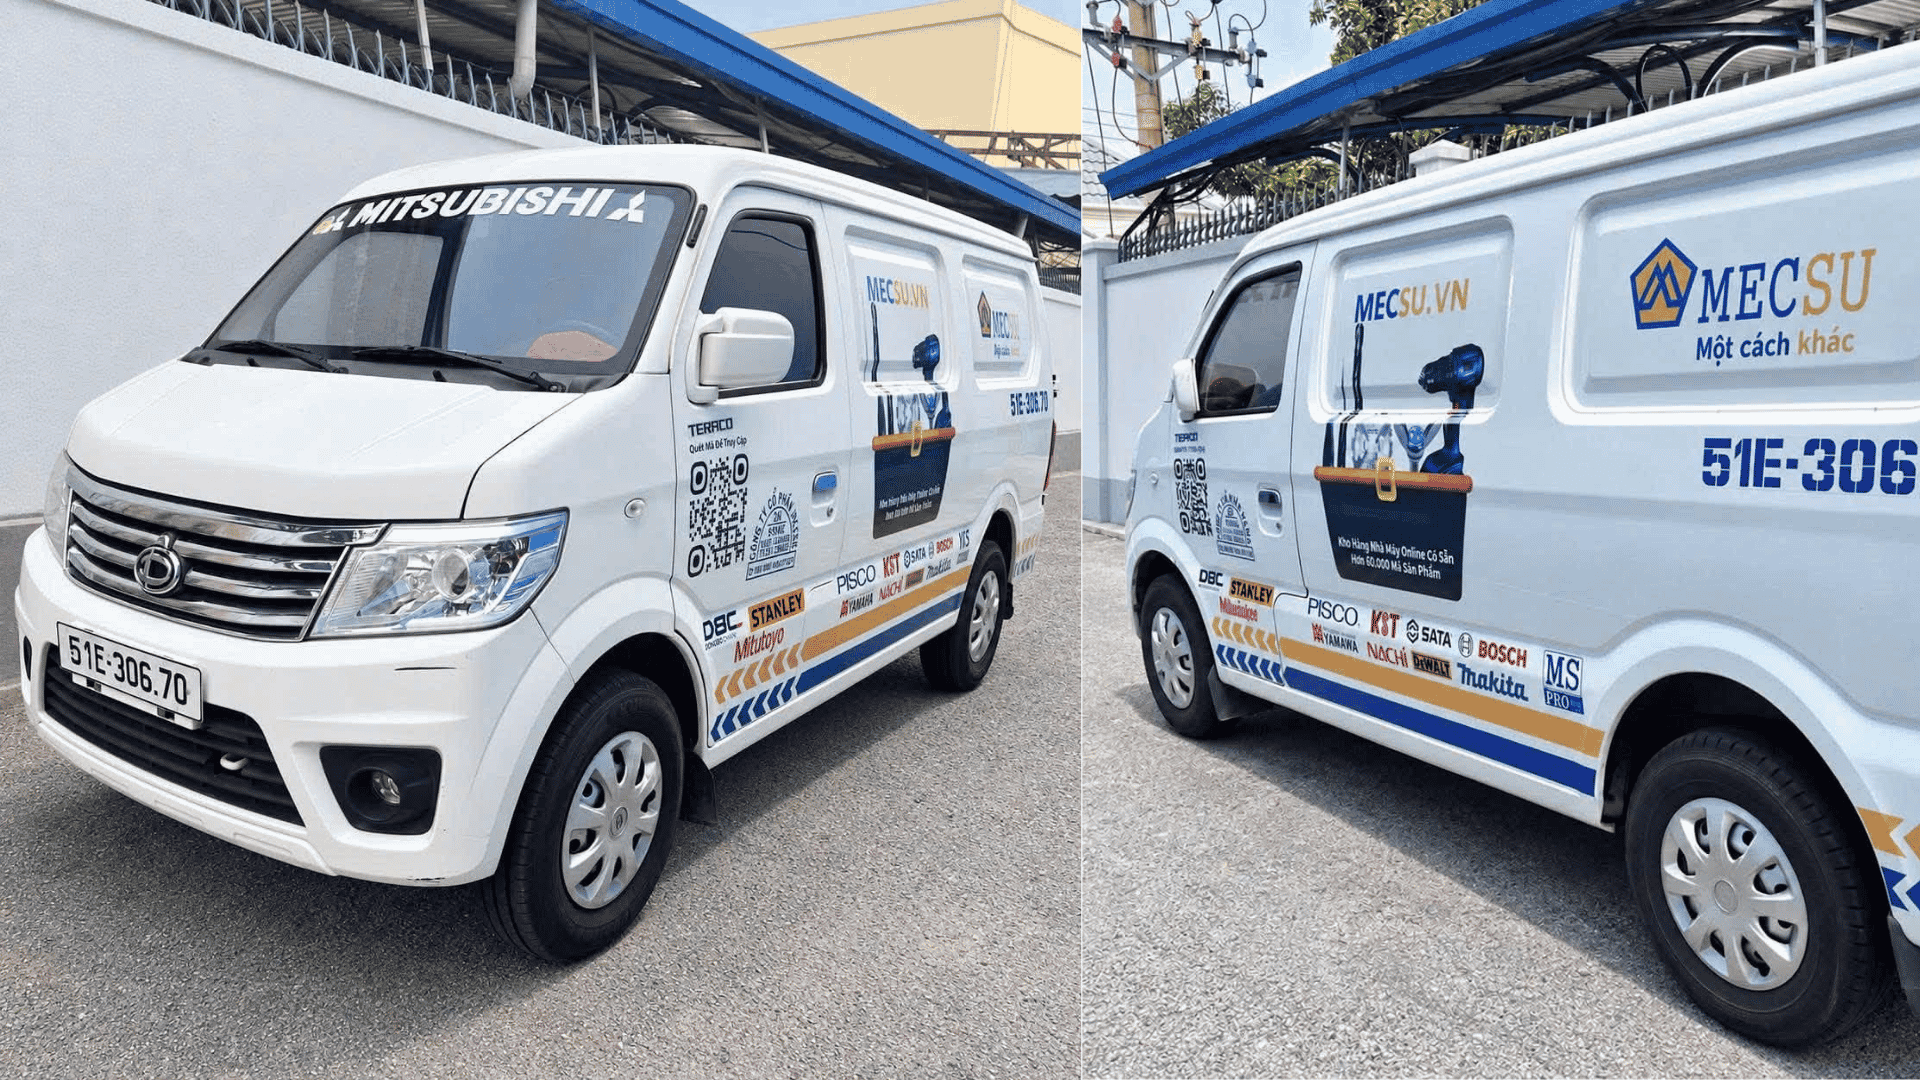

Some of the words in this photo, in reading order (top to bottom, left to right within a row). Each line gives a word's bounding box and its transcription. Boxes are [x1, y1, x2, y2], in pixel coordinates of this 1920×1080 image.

[347, 186, 616, 227] MITSUBISHI
[866, 275, 929, 308] MECSU.VN
[1354, 278, 1470, 323] MECSU.VN
[1697, 248, 1877, 324] MECSU
[1696, 335, 1733, 366] Một
[1740, 331, 1790, 357] cách
[1797, 326, 1855, 354] khác
[1009, 390, 1049, 416] 51E-306.70
[688, 417, 733, 437] TERACO
[1338, 536, 1351, 548] Kho
[1351, 537, 1370, 554] Hàng
[1370, 541, 1384, 554] Nhà
[1385, 543, 1400, 559] Máy
[1401, 546, 1426, 561] Online
[1427, 549, 1438, 562] Có
[1438, 549, 1454, 565] Sẵn
[1366, 555, 1390, 570] 60.000
[837, 564, 876, 595] PISCO
[1199, 569, 1224, 587] DBC
[1230, 580, 1273, 604] STANLEY
[751, 592, 802, 628] STANLEY
[1307, 597, 1359, 627] PISCO
[1371, 609, 1401, 638] KST
[702, 610, 737, 641] DBC
[1421, 627, 1452, 648] SATA
[733, 627, 785, 663] Mitutoyo
[1478, 640, 1527, 668] BOSCH
[68, 635, 188, 706] 51E-306.70
[1546, 654, 1580, 691] MS
[1546, 691, 1569, 710] PRO
